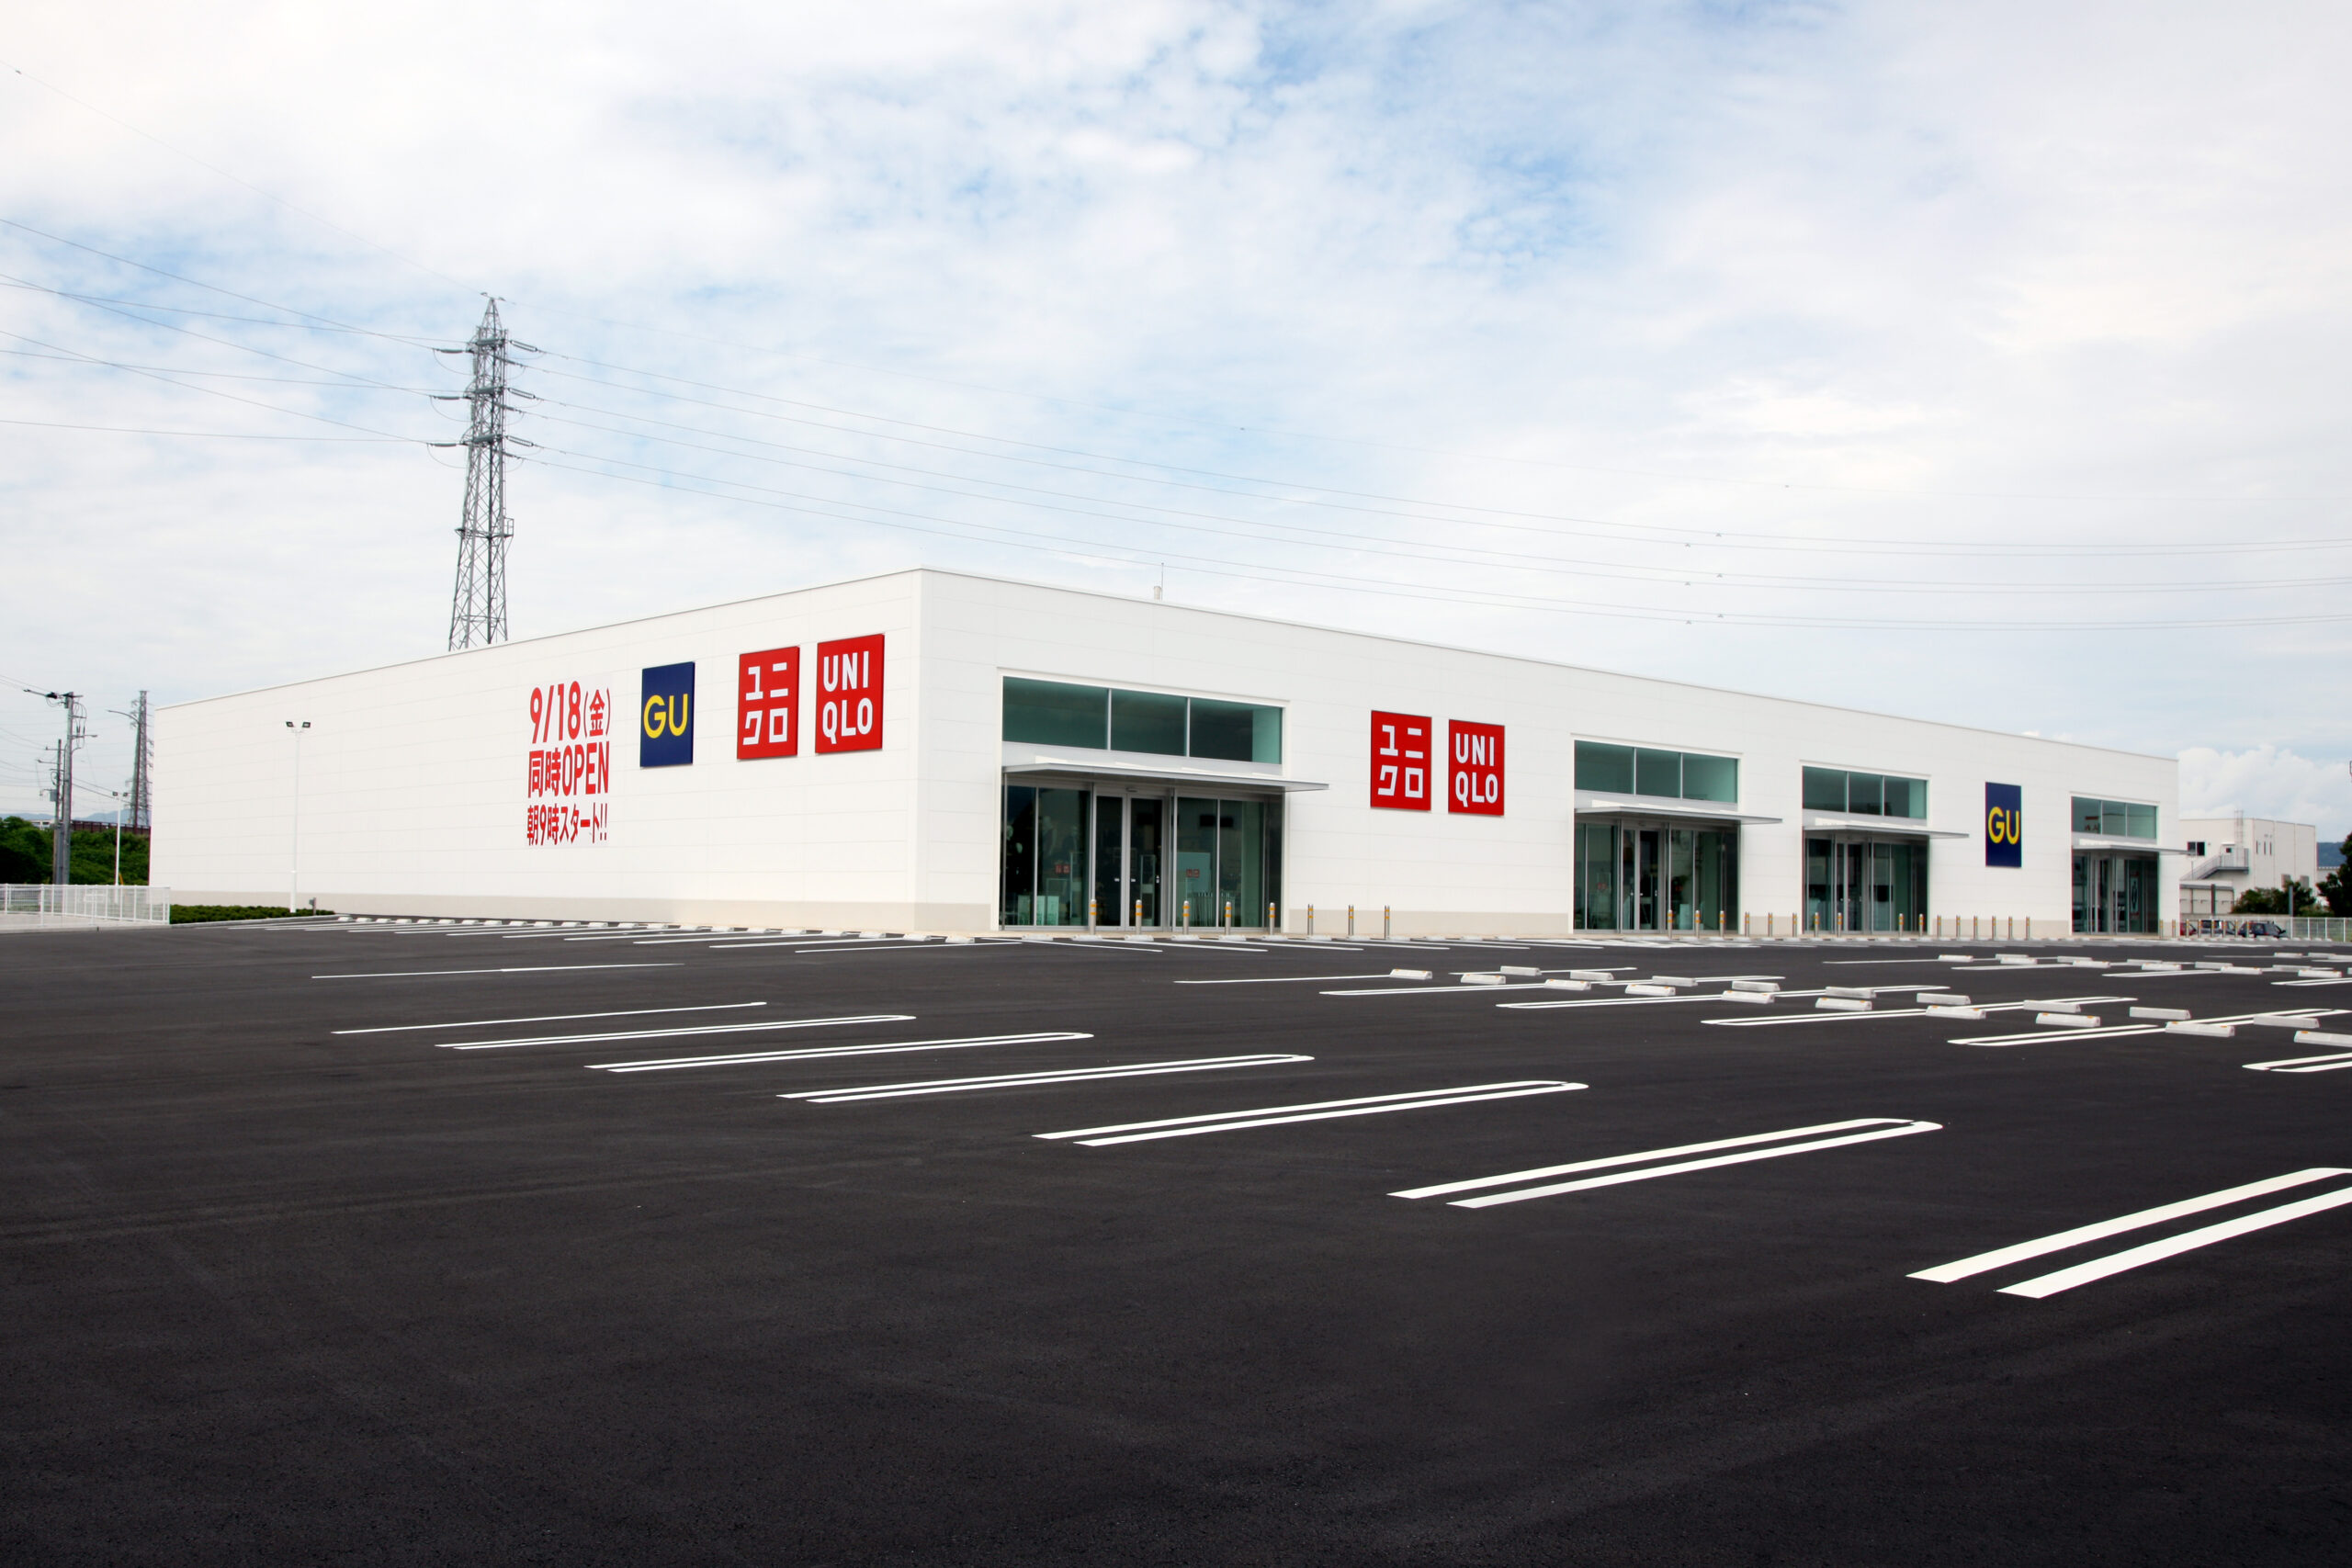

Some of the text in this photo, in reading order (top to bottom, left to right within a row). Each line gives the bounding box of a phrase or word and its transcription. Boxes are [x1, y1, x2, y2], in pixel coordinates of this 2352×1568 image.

[745, 661, 789, 701] ユニ
[822, 650, 869, 693] UNI
[529, 680, 611, 744] 9/18(金)
[643, 694, 689, 739] GU
[742, 707, 788, 746] クロ
[821, 697, 874, 745] QLO
[1379, 724, 1424, 760] ユニ
[1455, 732, 1495, 767] UNI
[527, 740, 610, 798] 同時OPEN
[1377, 764, 1424, 799] クロ
[1455, 771, 1498, 807] QLO
[1987, 806, 2020, 845] GU
